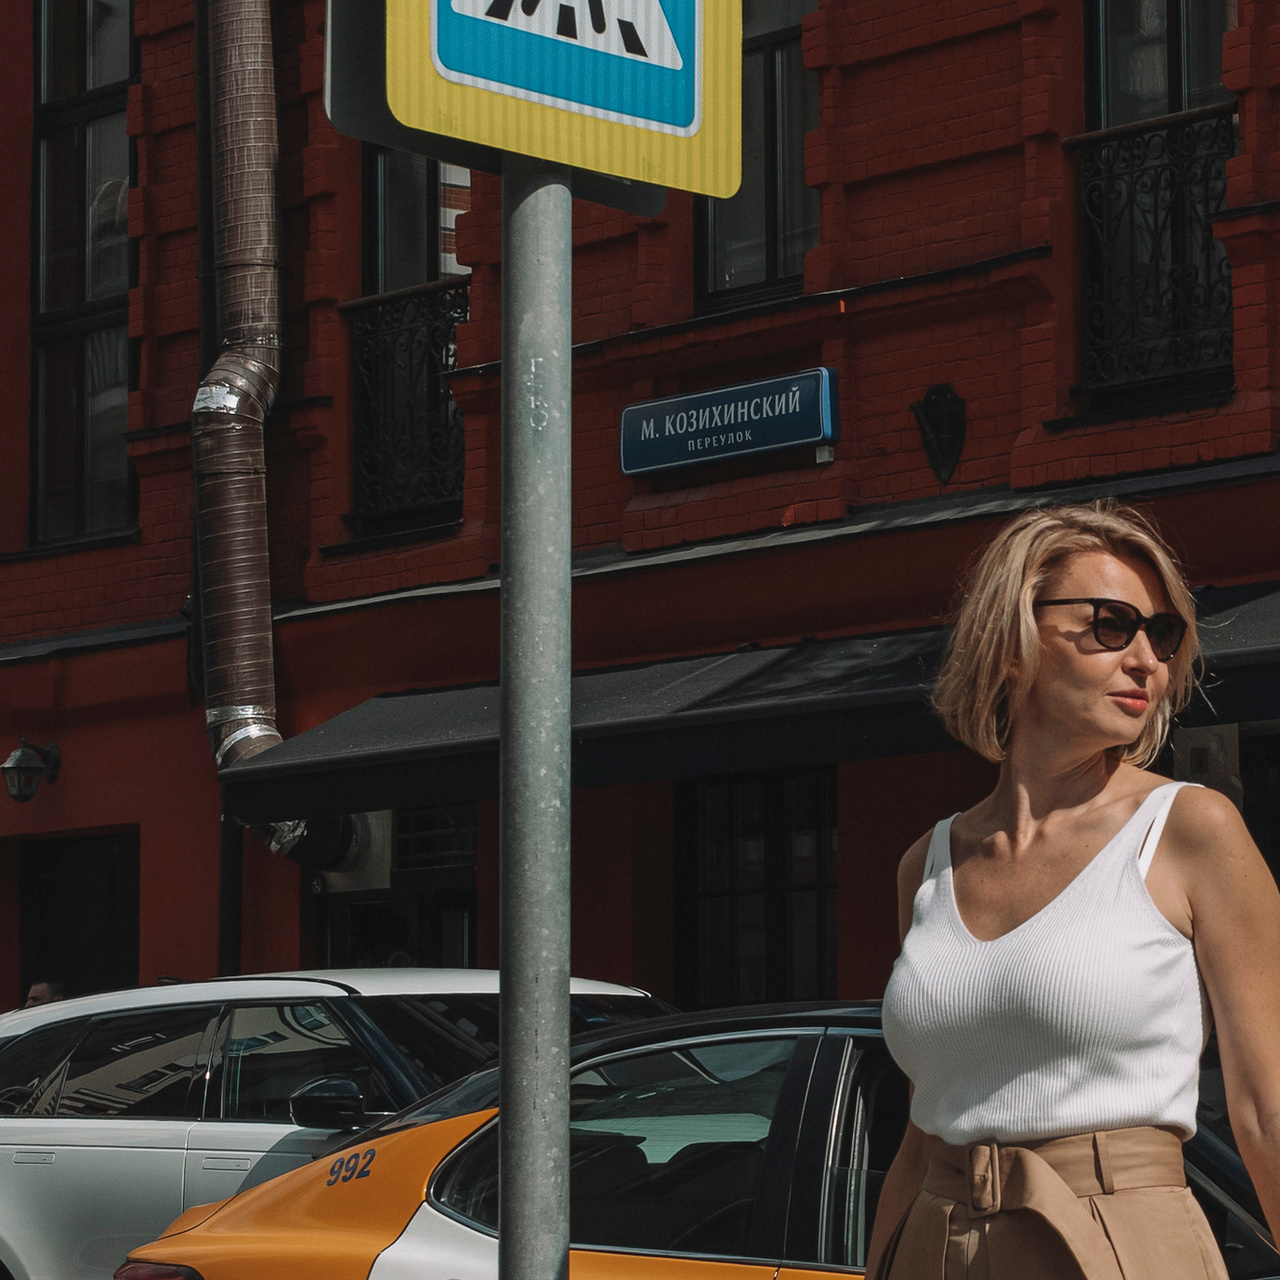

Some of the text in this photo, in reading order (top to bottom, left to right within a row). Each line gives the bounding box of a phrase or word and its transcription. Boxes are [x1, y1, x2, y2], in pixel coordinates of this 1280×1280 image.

[641, 386, 801, 441] М. КОЗИХИНСКИЙ
[687, 429, 753, 452] ПЕРЕУЛОК
[326, 1148, 376, 1187] 992
